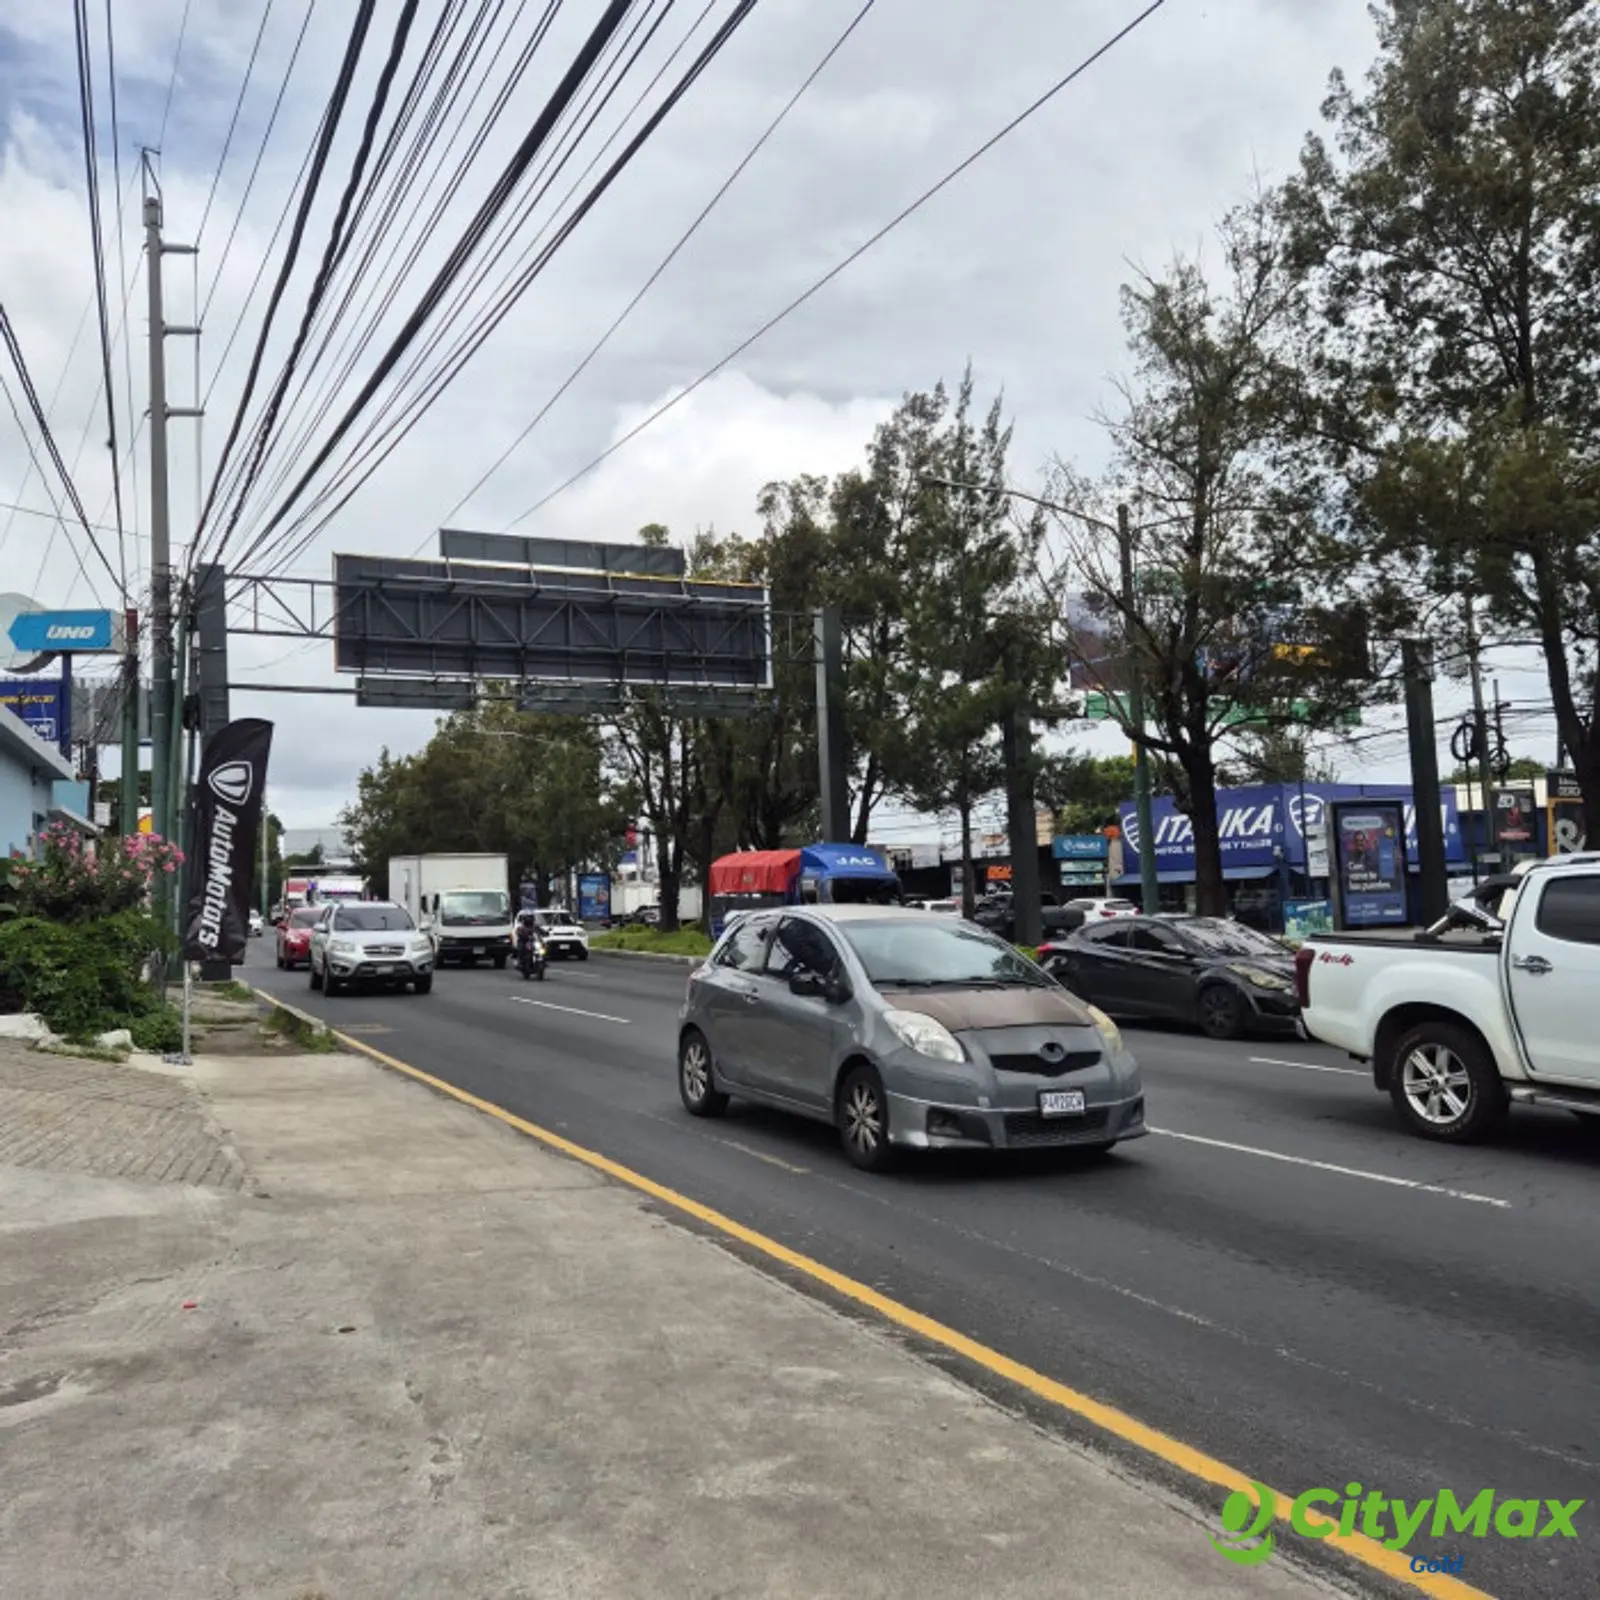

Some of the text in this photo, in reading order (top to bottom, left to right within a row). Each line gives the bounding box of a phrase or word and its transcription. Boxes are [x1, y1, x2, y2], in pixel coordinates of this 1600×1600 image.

[46, 624, 95, 639] UNO
[1154, 804, 1275, 844] ITAIKA
[199, 804, 239, 948] AutoMotors
